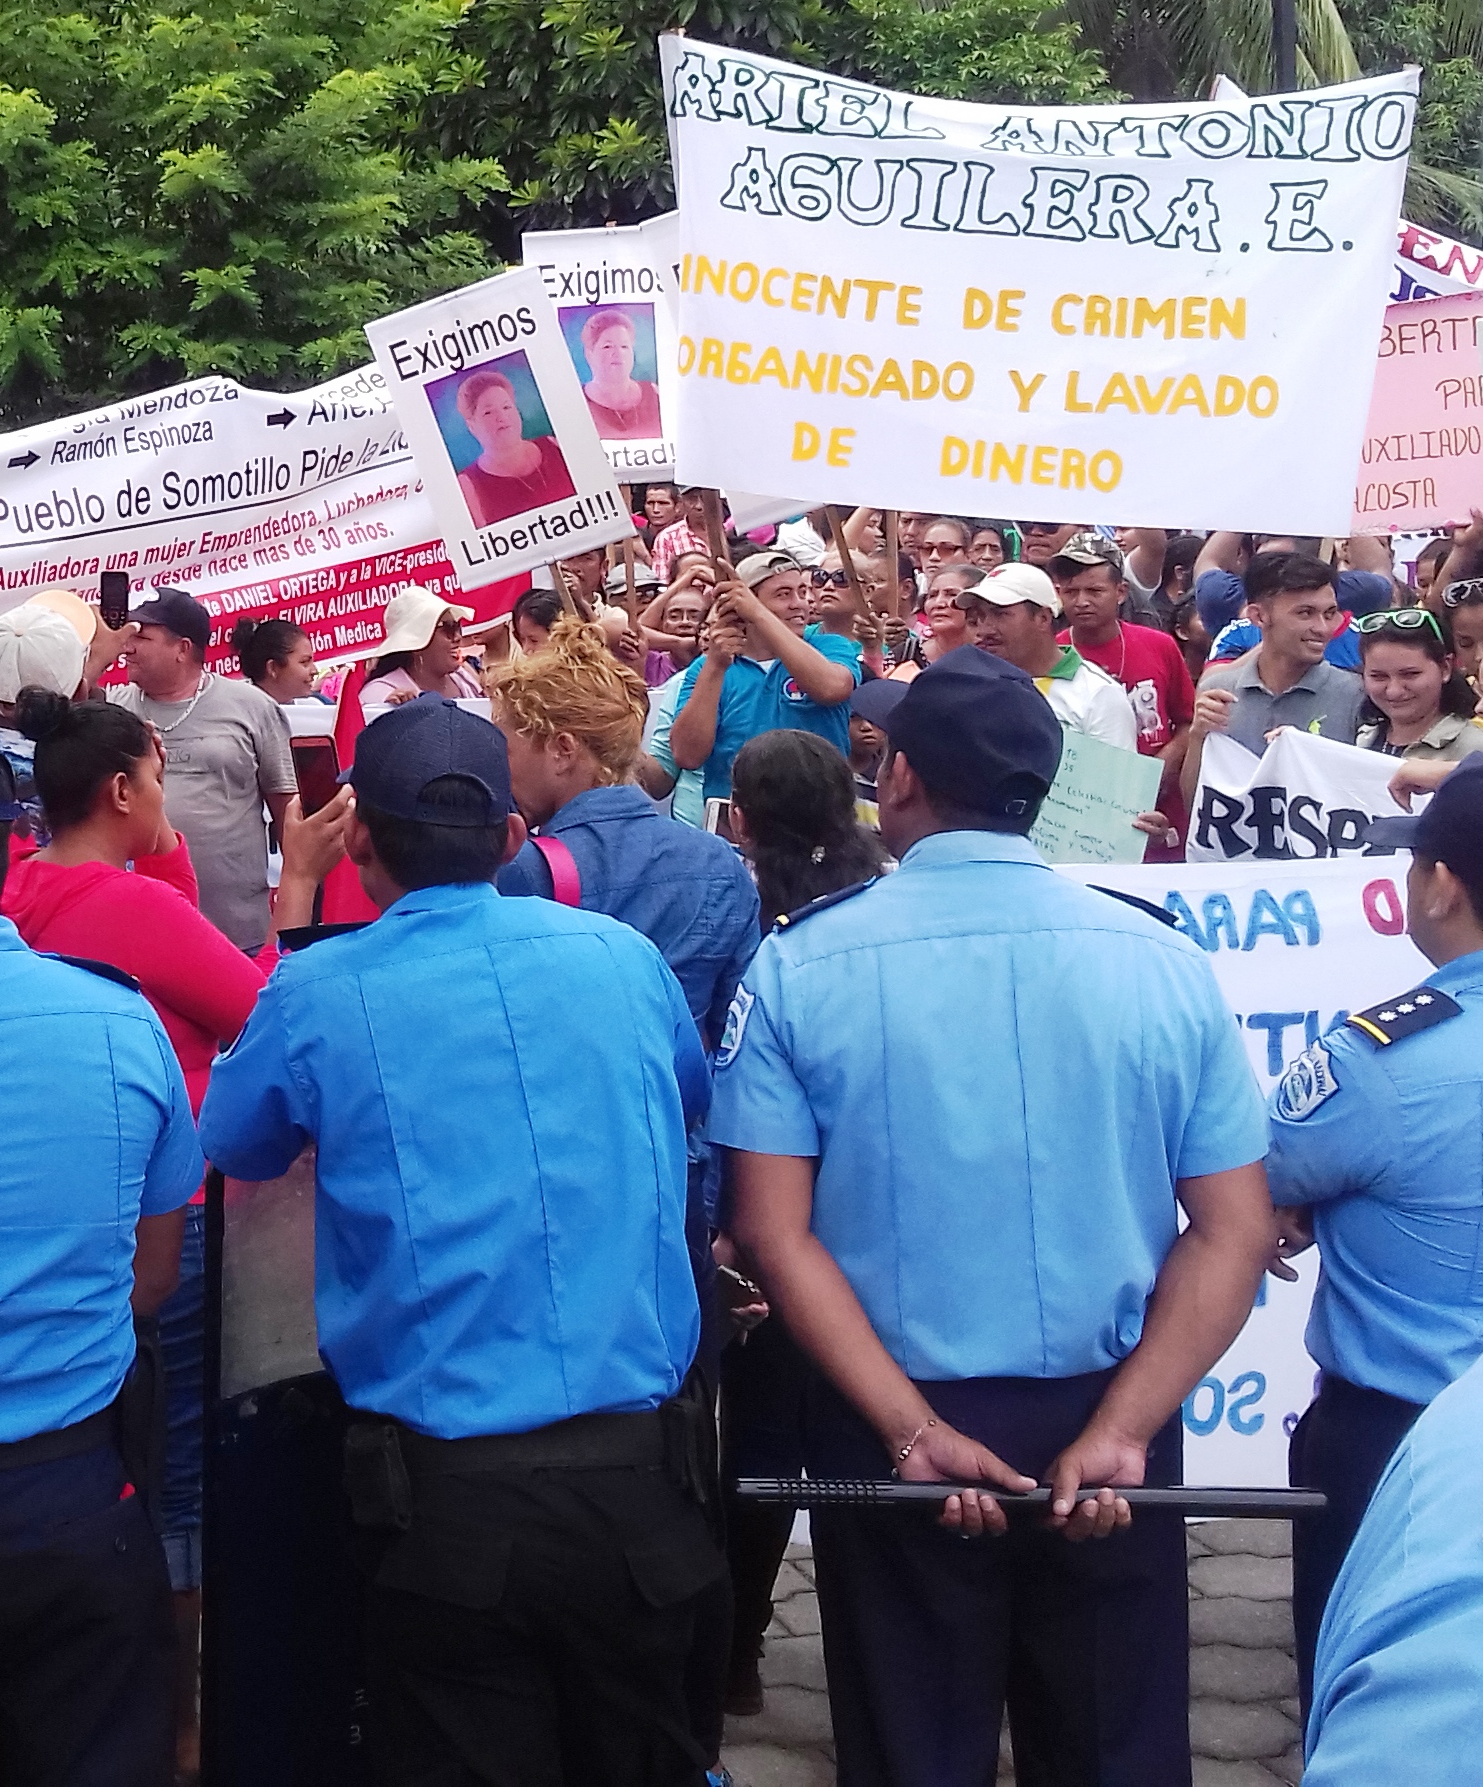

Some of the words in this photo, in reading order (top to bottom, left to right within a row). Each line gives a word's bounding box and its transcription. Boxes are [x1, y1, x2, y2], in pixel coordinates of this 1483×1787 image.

[670, 51, 946, 139] ARIEL
[981, 91, 1418, 162] ANTONIO
[681, 253, 923, 326] INOCENTE
[962, 286, 1026, 333] DE
[1050, 293, 1248, 341] CRIMEN
[388, 305, 537, 382] Exigimos
[1378, 316, 1483, 359] BERT
[677, 333, 975, 402] ORGANISADO
[1008, 369, 1047, 413] Y
[1064, 370, 1280, 419] LAVADO
[1435, 375, 1483, 411] PA
[50, 432, 117, 466] Ramón
[124, 420, 214, 457] Espinoza
[791, 421, 858, 467] DE
[939, 434, 1124, 494] DINERO
[1361, 425, 1481, 465] UXILIADO
[117, 479, 152, 519] de
[162, 455, 291, 510] Somotillo
[300, 446, 354, 486] Pide
[105, 551, 139, 571] una
[143, 537, 196, 566] mujer
[253, 546, 291, 567] mas
[293, 534, 316, 556] de
[317, 526, 341, 550] 30
[344, 521, 395, 545] años.
[460, 489, 620, 567] Libertad!!!
[223, 583, 279, 615] DANIEL
[279, 567, 338, 601] ORTEGA
[360, 561, 372, 580] la
[309, 629, 333, 652] ión
[333, 620, 383, 648] Medica
